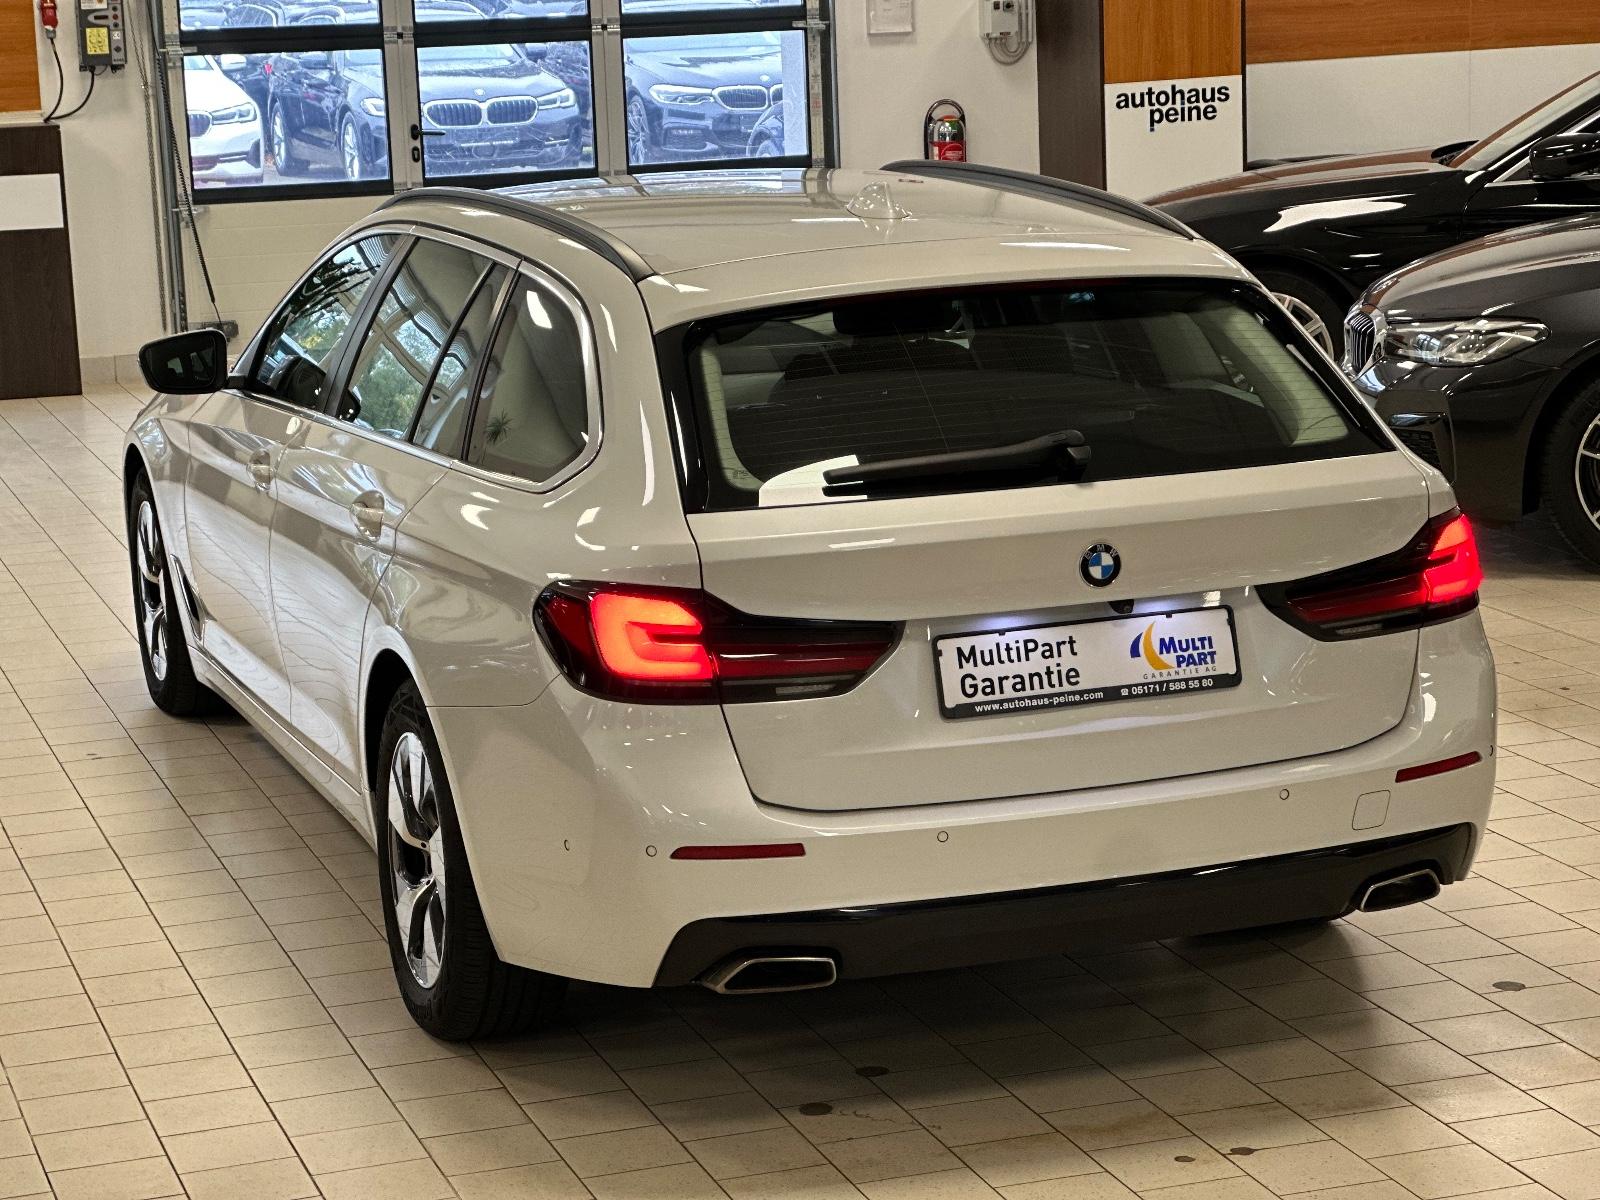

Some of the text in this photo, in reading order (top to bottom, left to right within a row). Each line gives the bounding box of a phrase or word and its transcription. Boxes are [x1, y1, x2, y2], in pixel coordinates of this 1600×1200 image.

[1115, 84, 1230, 109] autohaus
[1149, 101, 1217, 132] peine
[1083, 543, 1119, 560] BMW
[955, 635, 1078, 669] MultiPart
[1158, 636, 1214, 655] MULTI
[1175, 650, 1217, 668] PART
[960, 662, 1080, 698] Garantie
[1143, 668, 1199, 680] GARANTIE
[1131, 684, 1160, 695] 05171
[1168, 681, 1186, 691] 588
[1188, 679, 1200, 689] 55
[974, 690, 1104, 712] www.autohaus-peine.com
